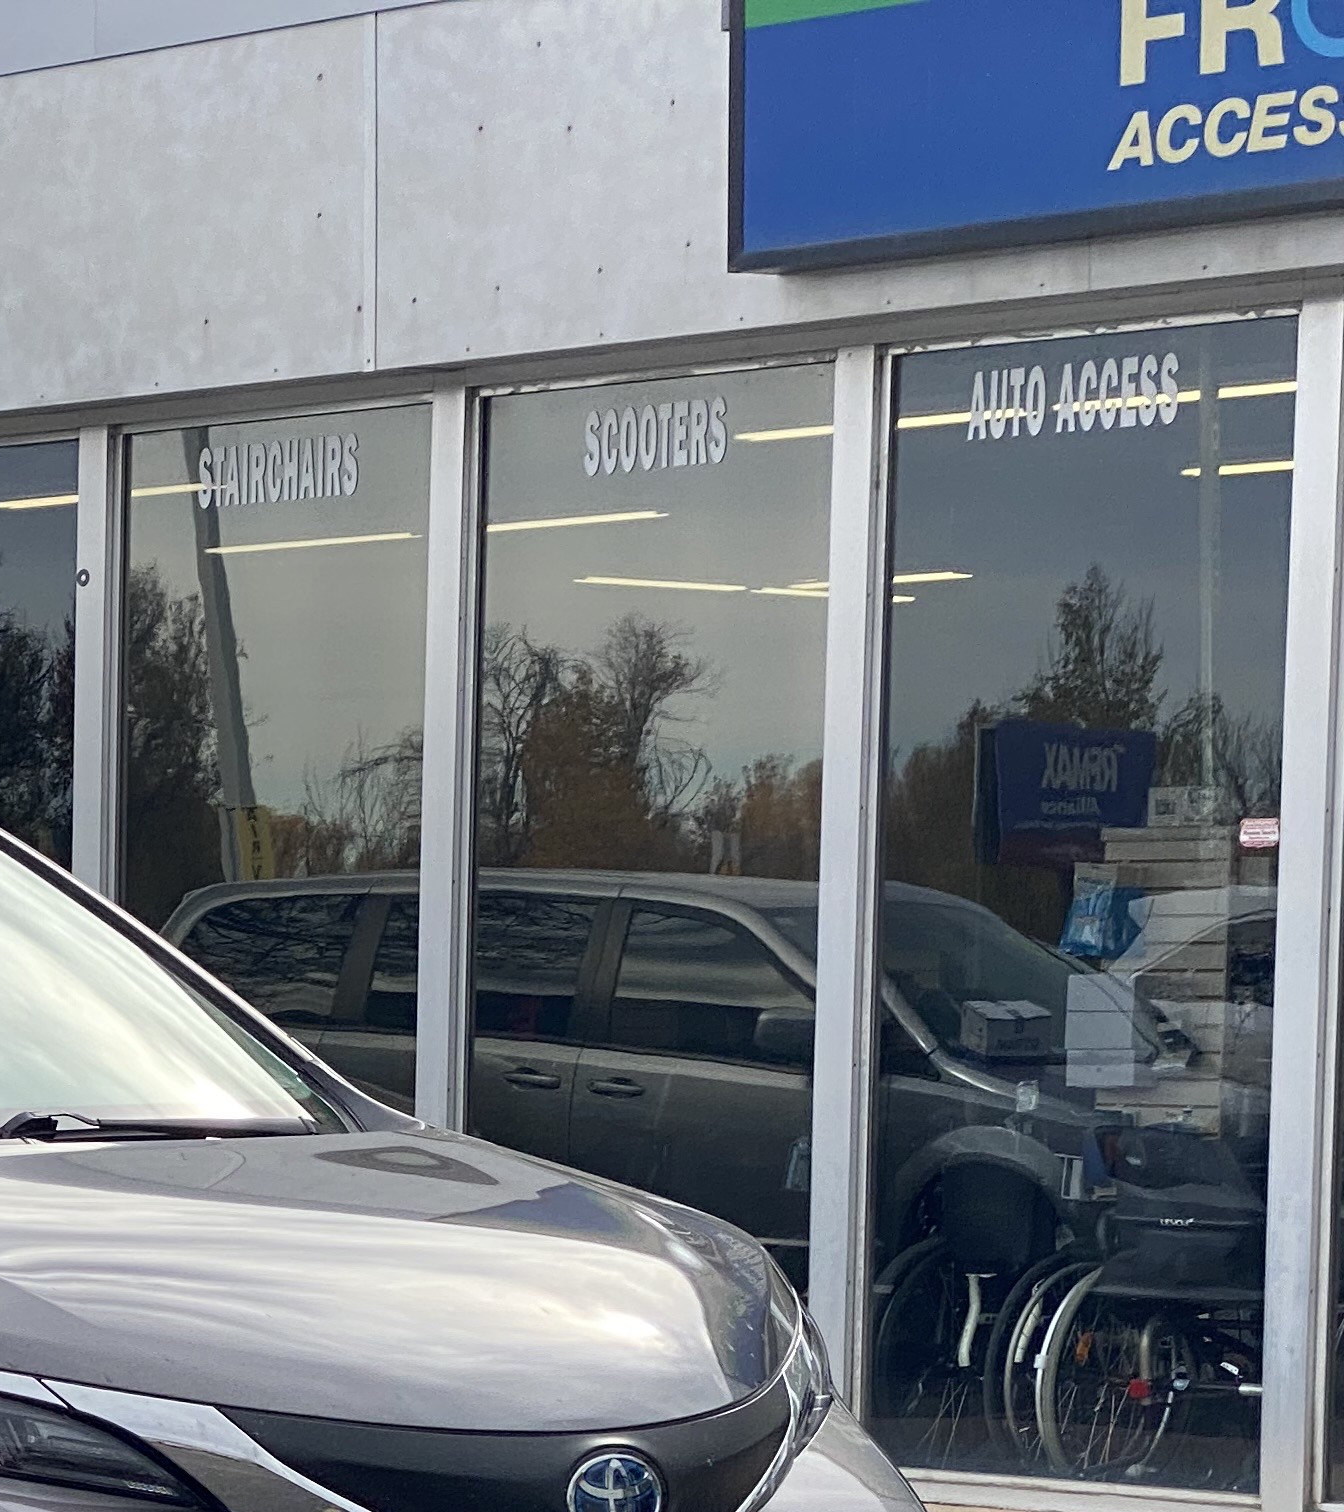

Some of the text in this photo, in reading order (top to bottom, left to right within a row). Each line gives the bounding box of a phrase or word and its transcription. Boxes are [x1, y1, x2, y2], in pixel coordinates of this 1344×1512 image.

[1107, 85, 1344, 171] ACCES
[584, 397, 727, 477] SCOOTERS
[967, 352, 1180, 441] AUTO ACCESS
[198, 434, 358, 509] STAIRCHAIRS
